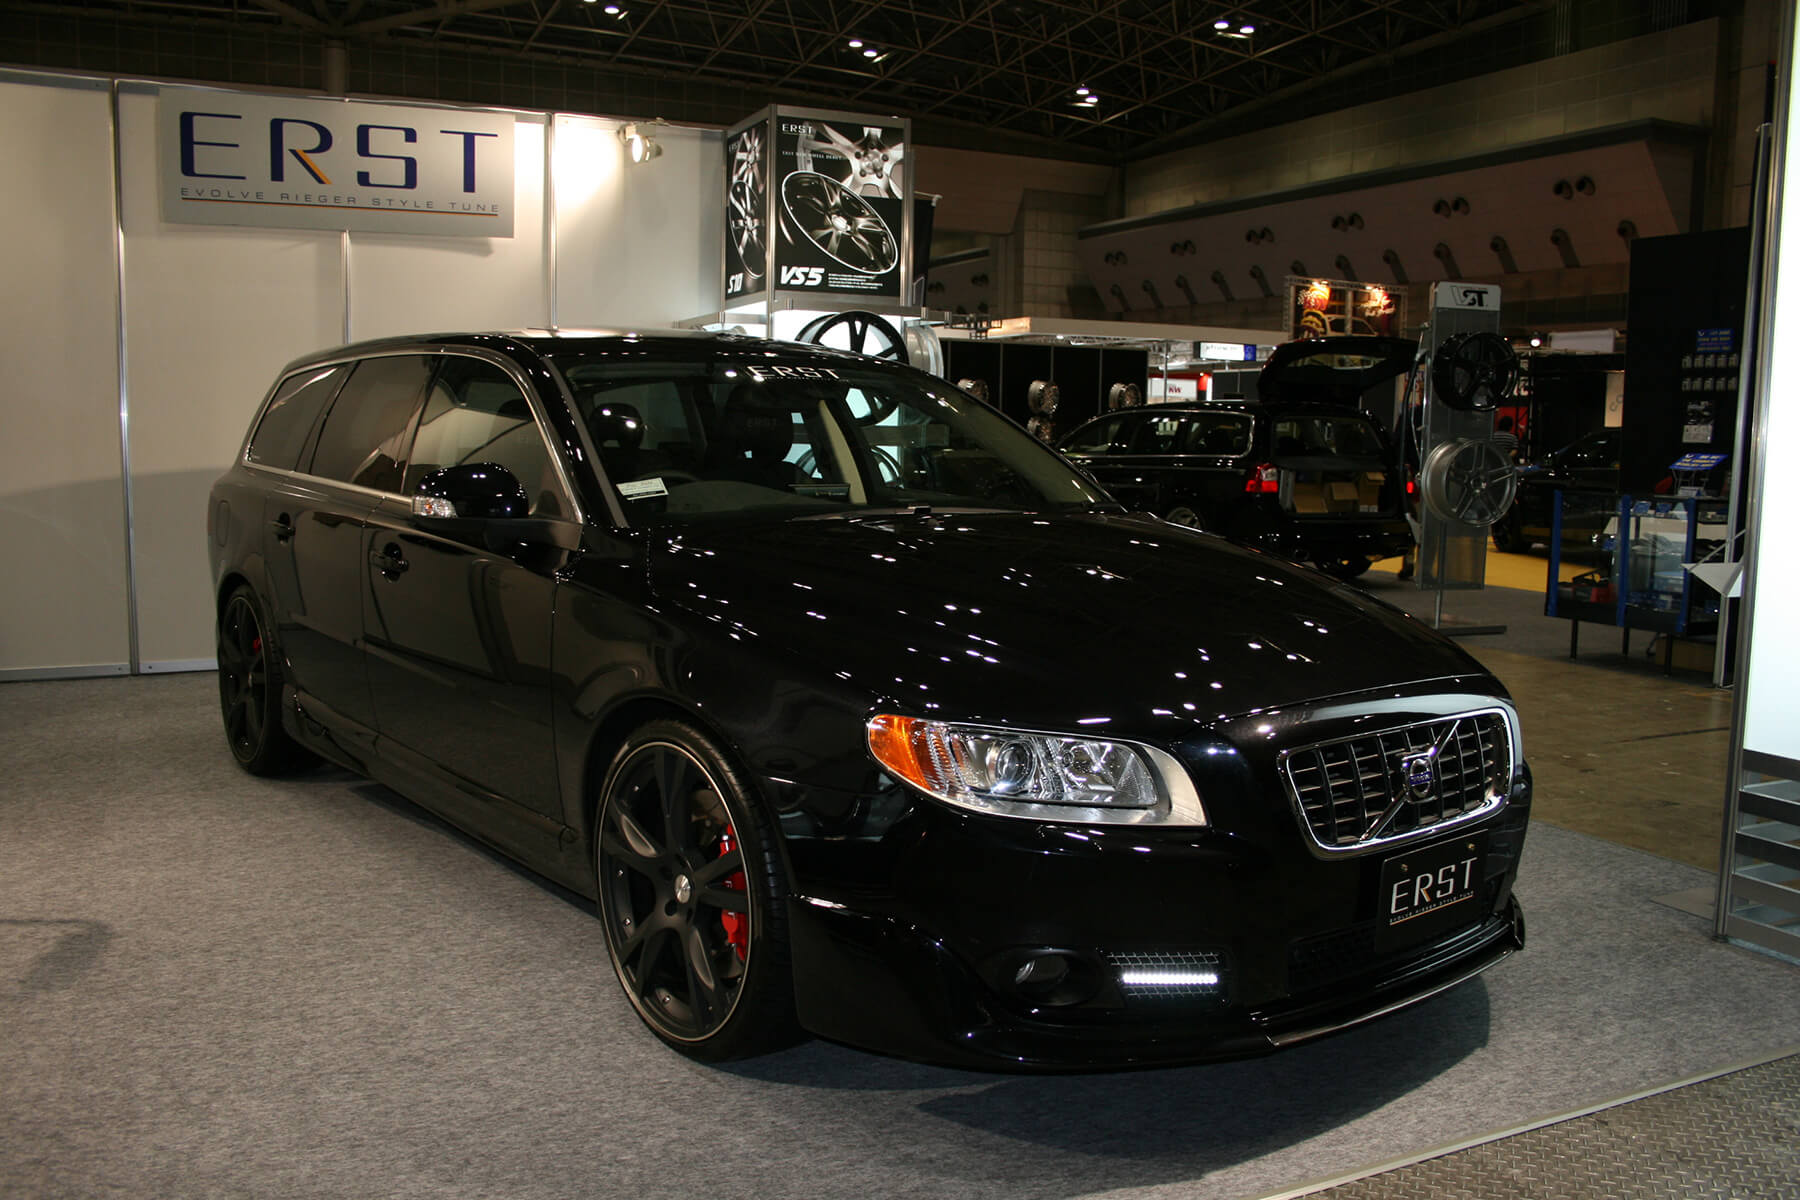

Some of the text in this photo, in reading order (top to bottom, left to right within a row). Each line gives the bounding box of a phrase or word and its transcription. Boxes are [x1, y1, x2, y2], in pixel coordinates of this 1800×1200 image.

[782, 123, 813, 135] ERST
[180, 111, 498, 193] ERST
[180, 187, 499, 213] EVOLVE RIEGER STYLE TUNE
[780, 265, 825, 286] VS5
[747, 366, 840, 379] ERST
[1391, 857, 1478, 914] ERST
